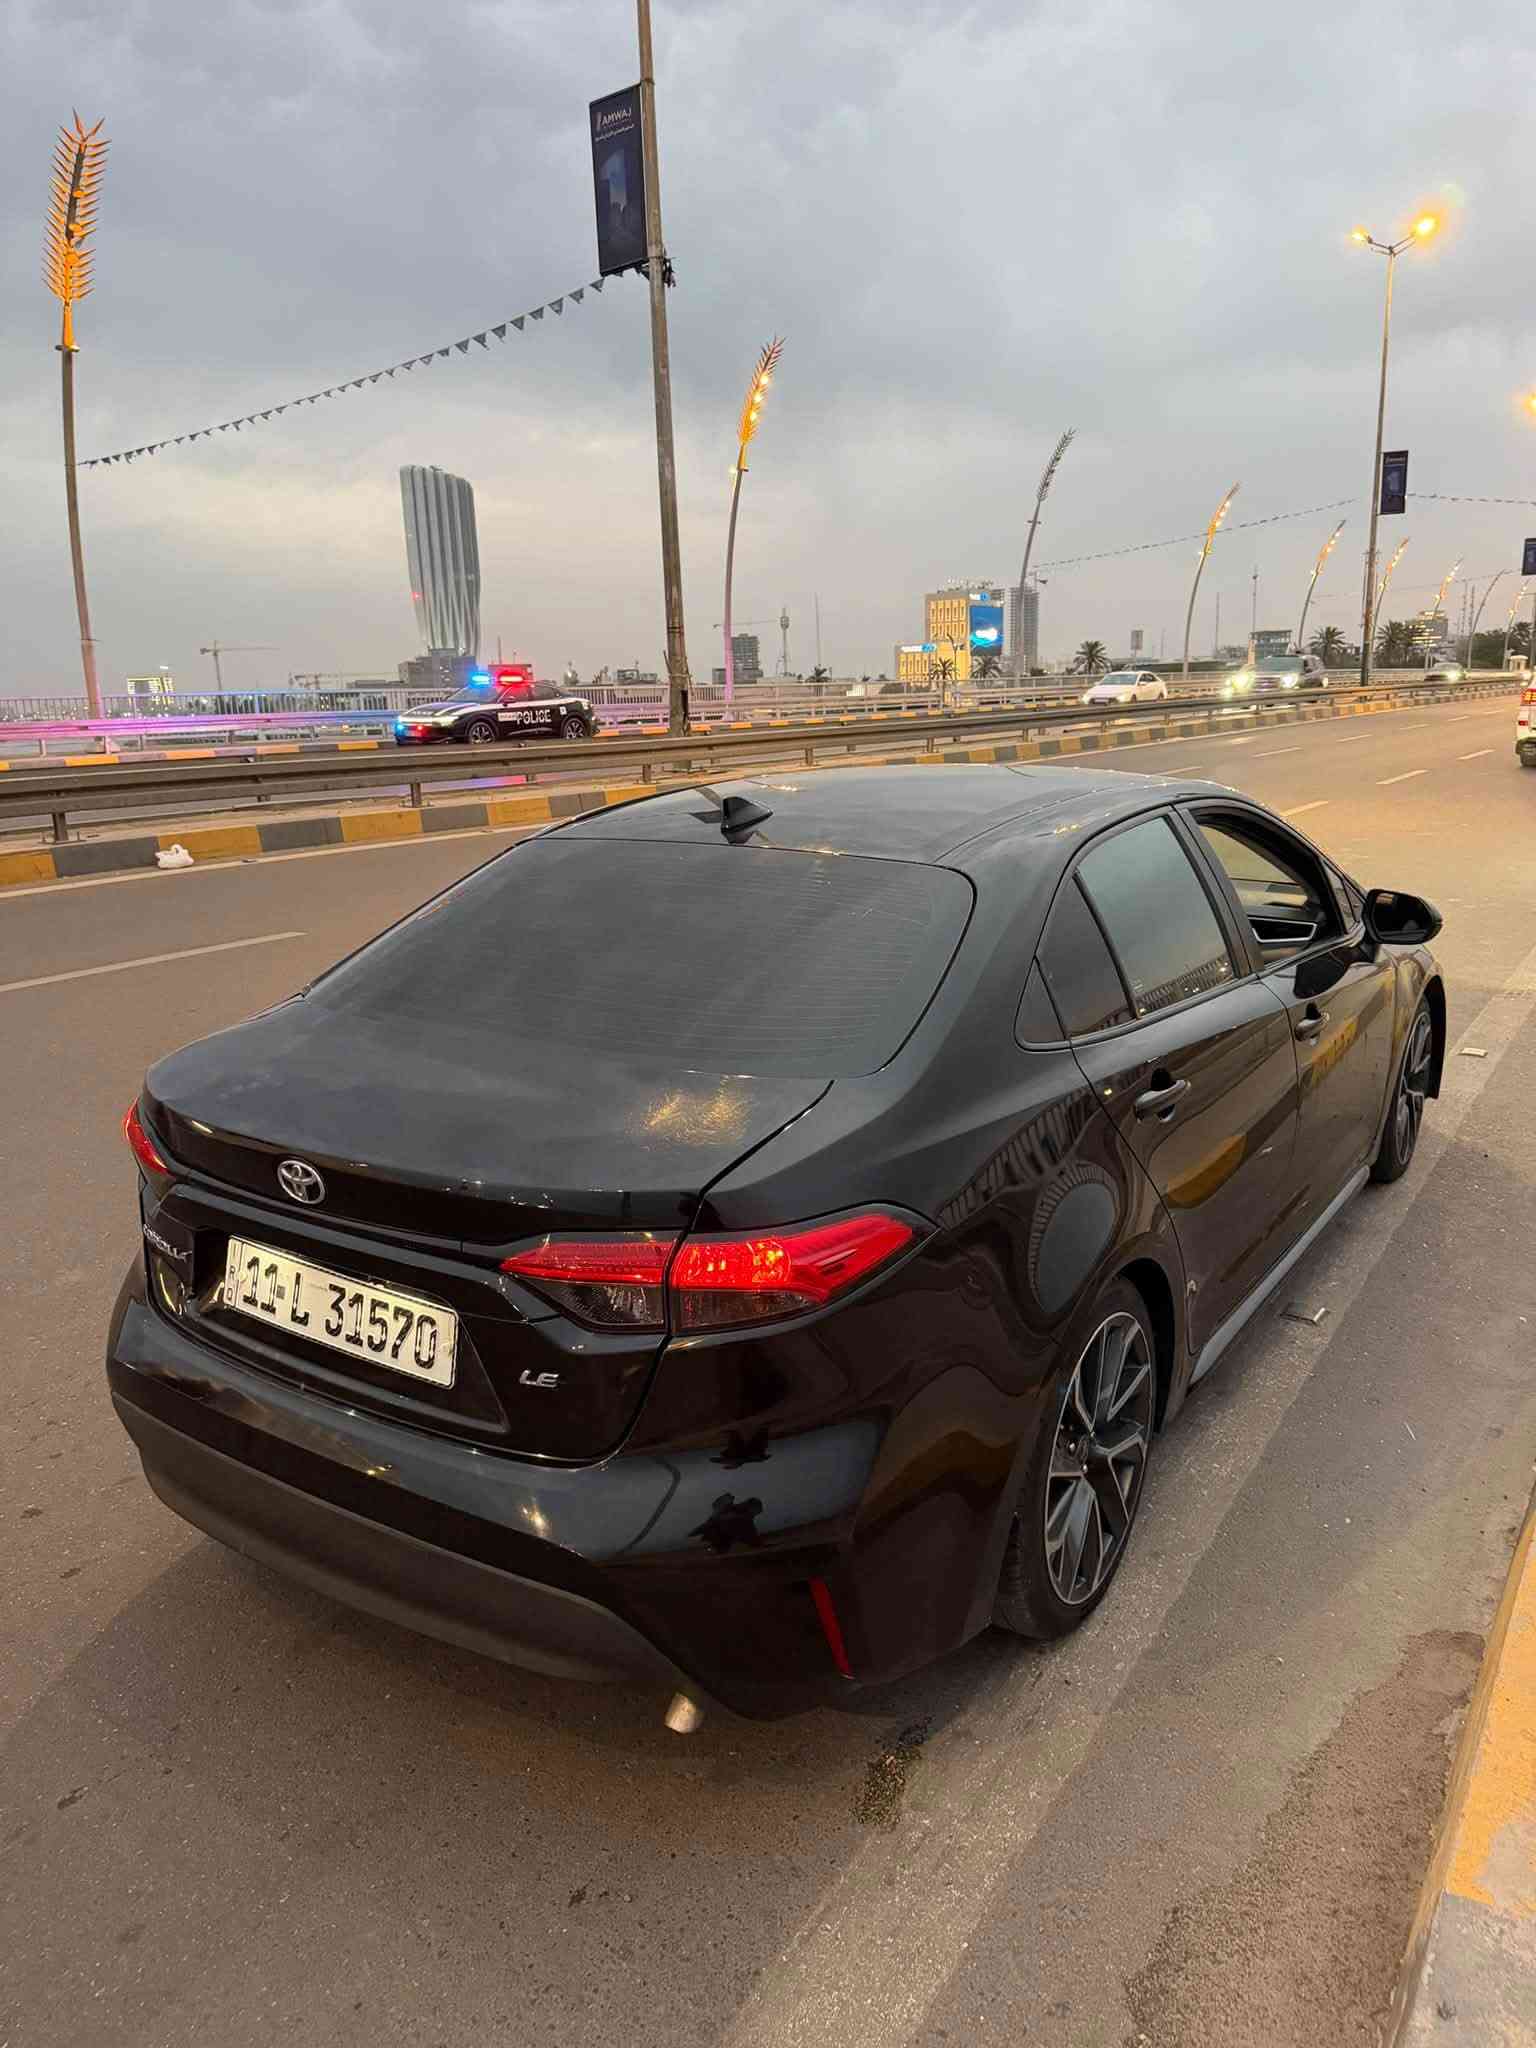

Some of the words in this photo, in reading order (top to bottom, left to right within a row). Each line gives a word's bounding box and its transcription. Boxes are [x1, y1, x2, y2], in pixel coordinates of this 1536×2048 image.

[601, 106, 632, 124] AMWAJ
[517, 709, 552, 724] POLICE
[324, 1283, 437, 1370] 31570
[519, 1369, 559, 1388] LE
